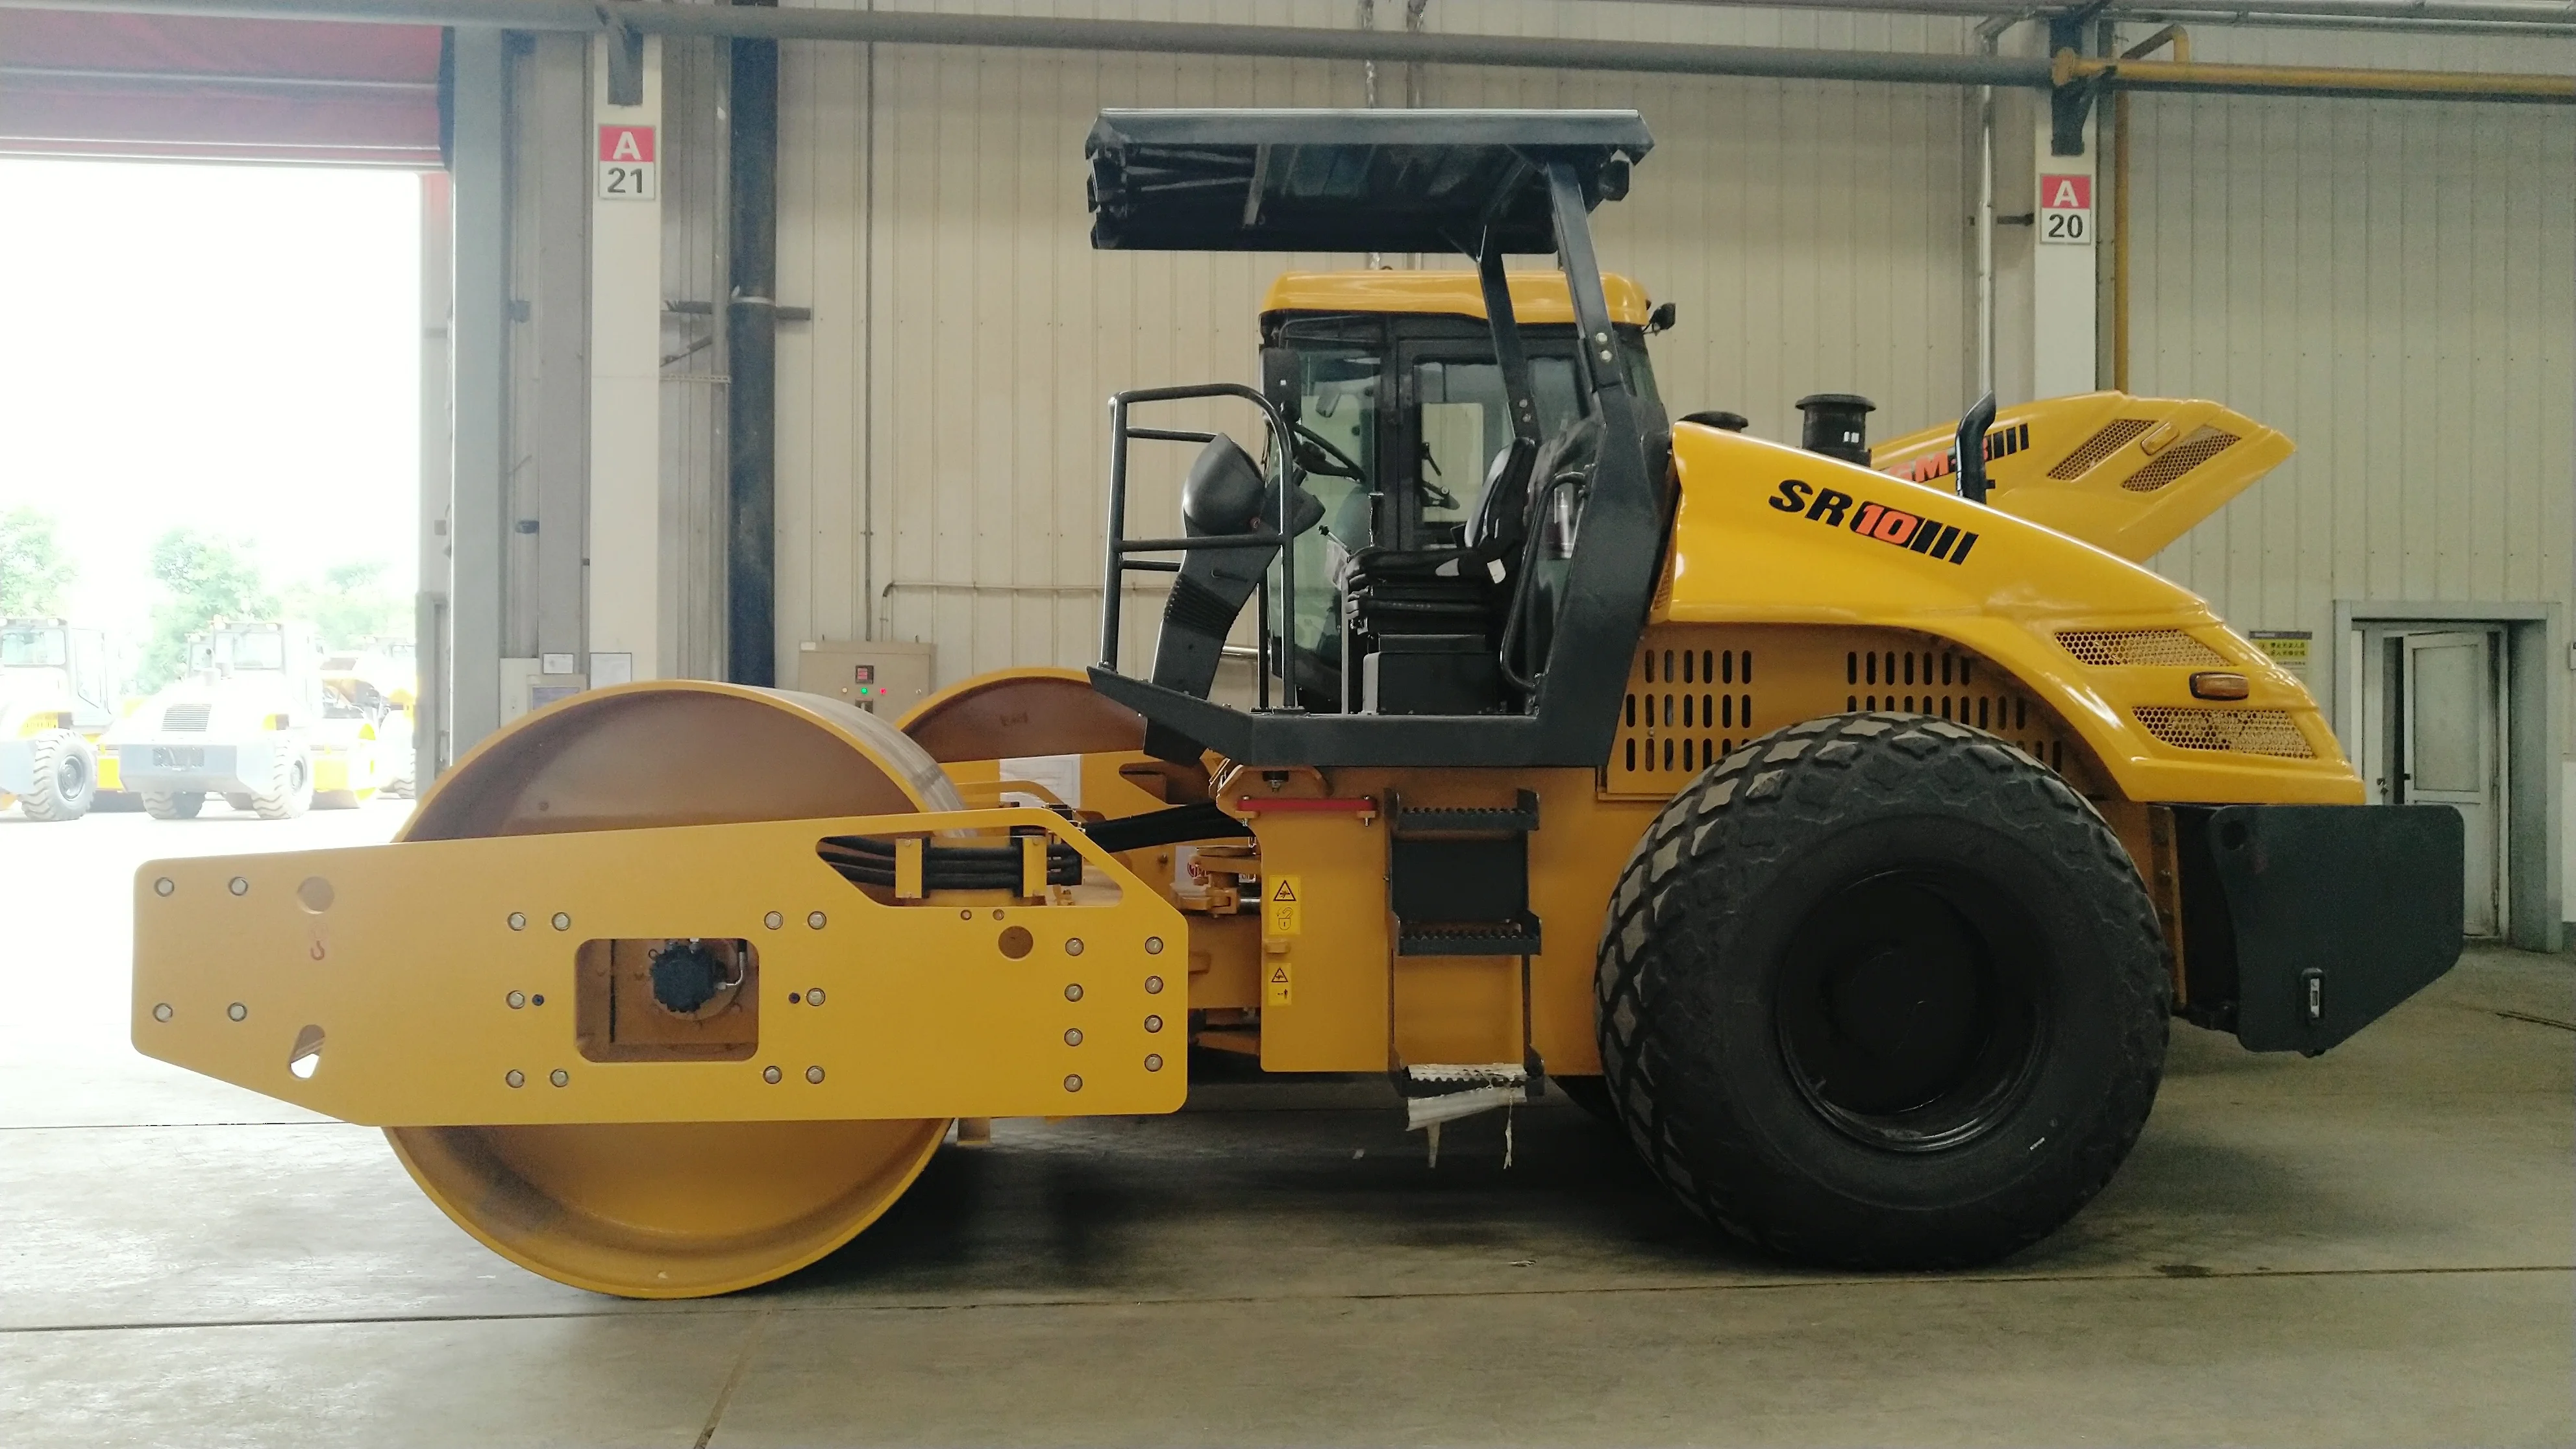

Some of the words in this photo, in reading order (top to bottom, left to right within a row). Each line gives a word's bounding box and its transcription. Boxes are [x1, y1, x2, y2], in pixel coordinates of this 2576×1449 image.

[613, 131, 641, 160] A
[608, 167, 643, 193] 21
[2053, 180, 2079, 207] A
[2048, 214, 2083, 238] 20
